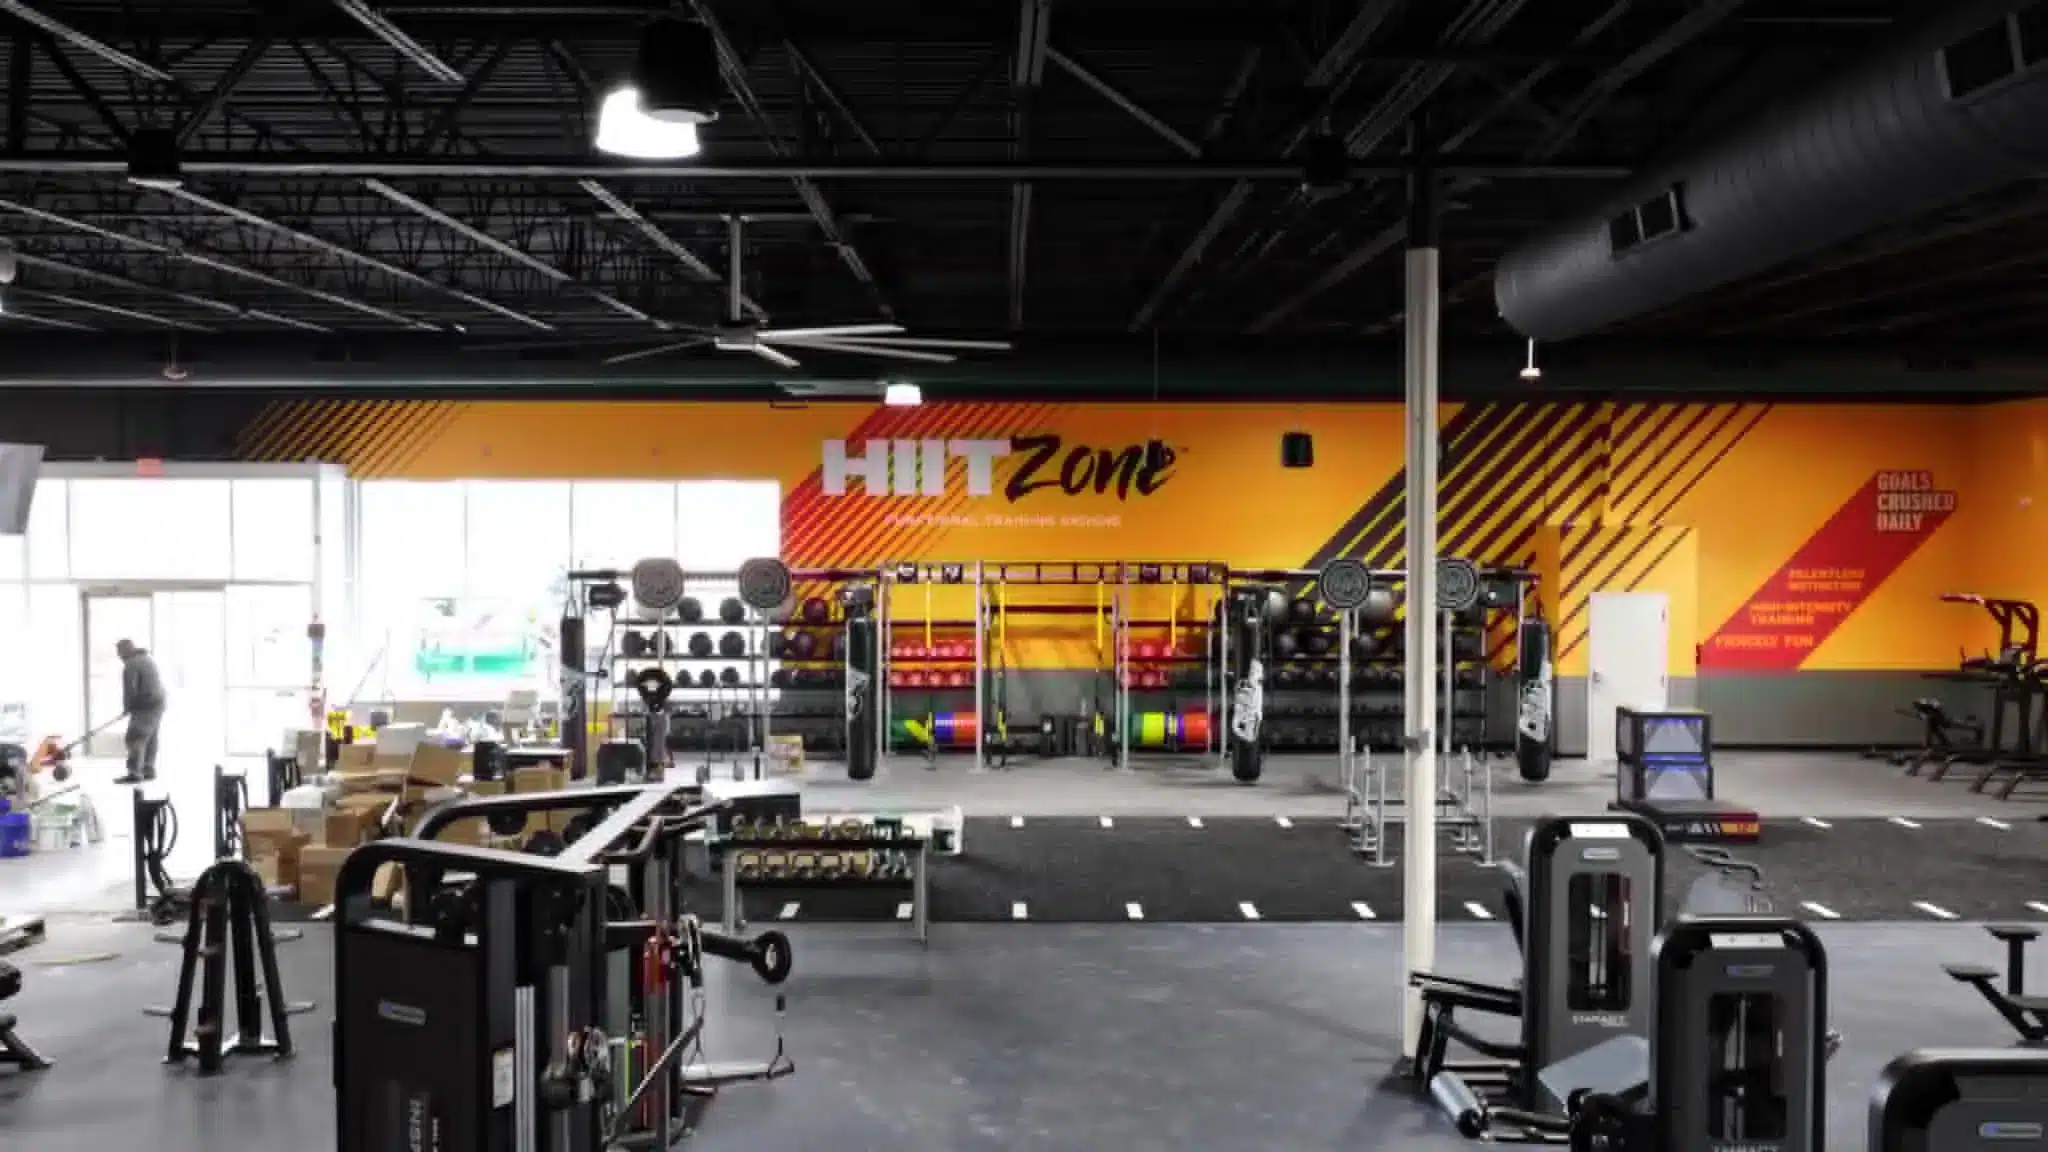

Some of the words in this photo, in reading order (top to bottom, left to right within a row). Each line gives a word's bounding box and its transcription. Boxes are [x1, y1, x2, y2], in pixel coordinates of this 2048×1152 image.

[823, 439, 1011, 495] HIIT
[1877, 471, 1931, 489] GOALS
[1877, 492, 1954, 511] CRUSHED
[1877, 512, 1922, 532] DAILY
